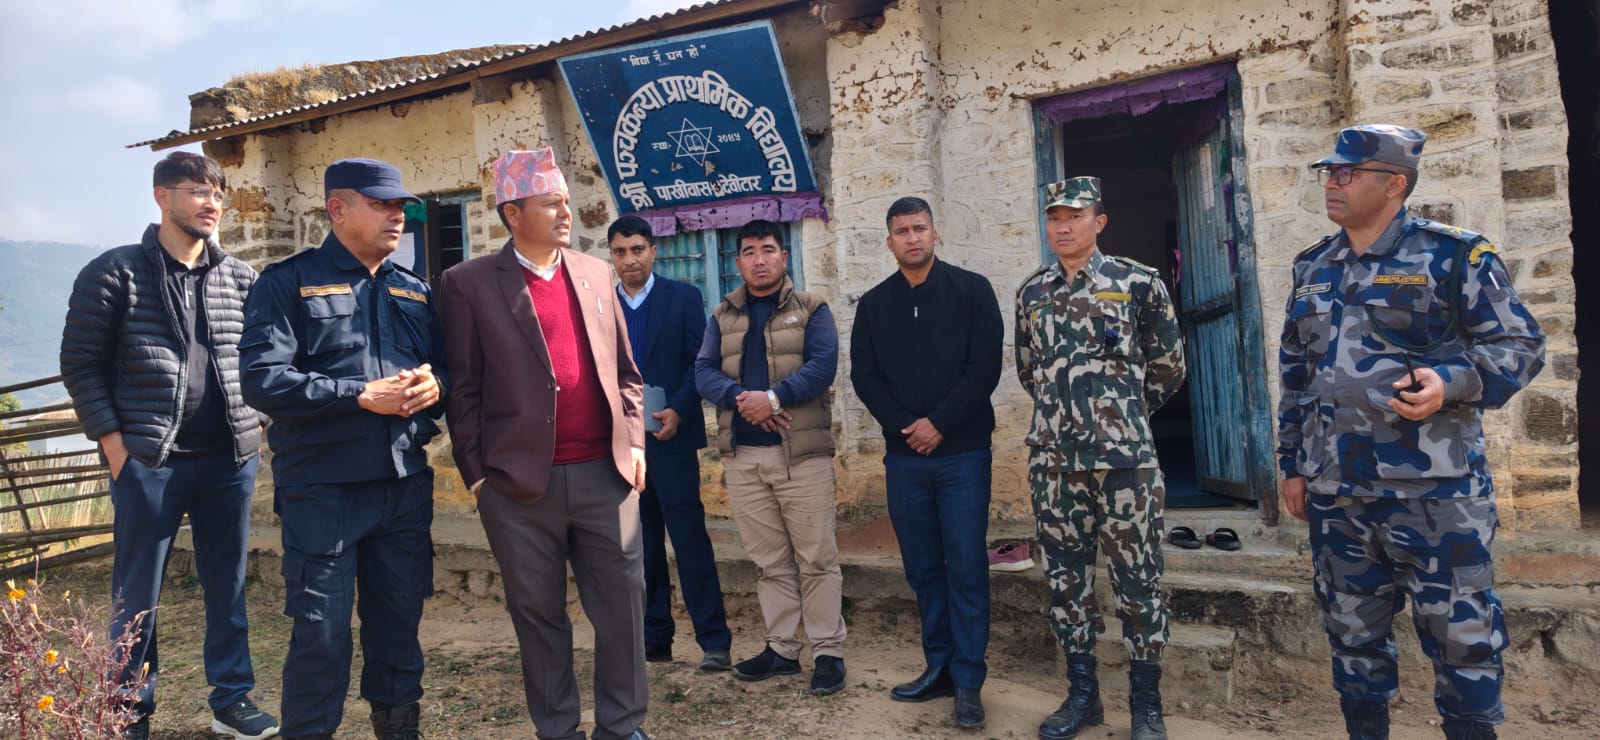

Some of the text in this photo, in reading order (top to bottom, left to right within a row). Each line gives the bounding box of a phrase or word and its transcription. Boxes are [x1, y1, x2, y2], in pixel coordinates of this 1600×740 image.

[619, 180, 654, 211] श्री
[657, 69, 753, 120] प्राथमिक
[744, 106, 797, 192] विद्यालय
